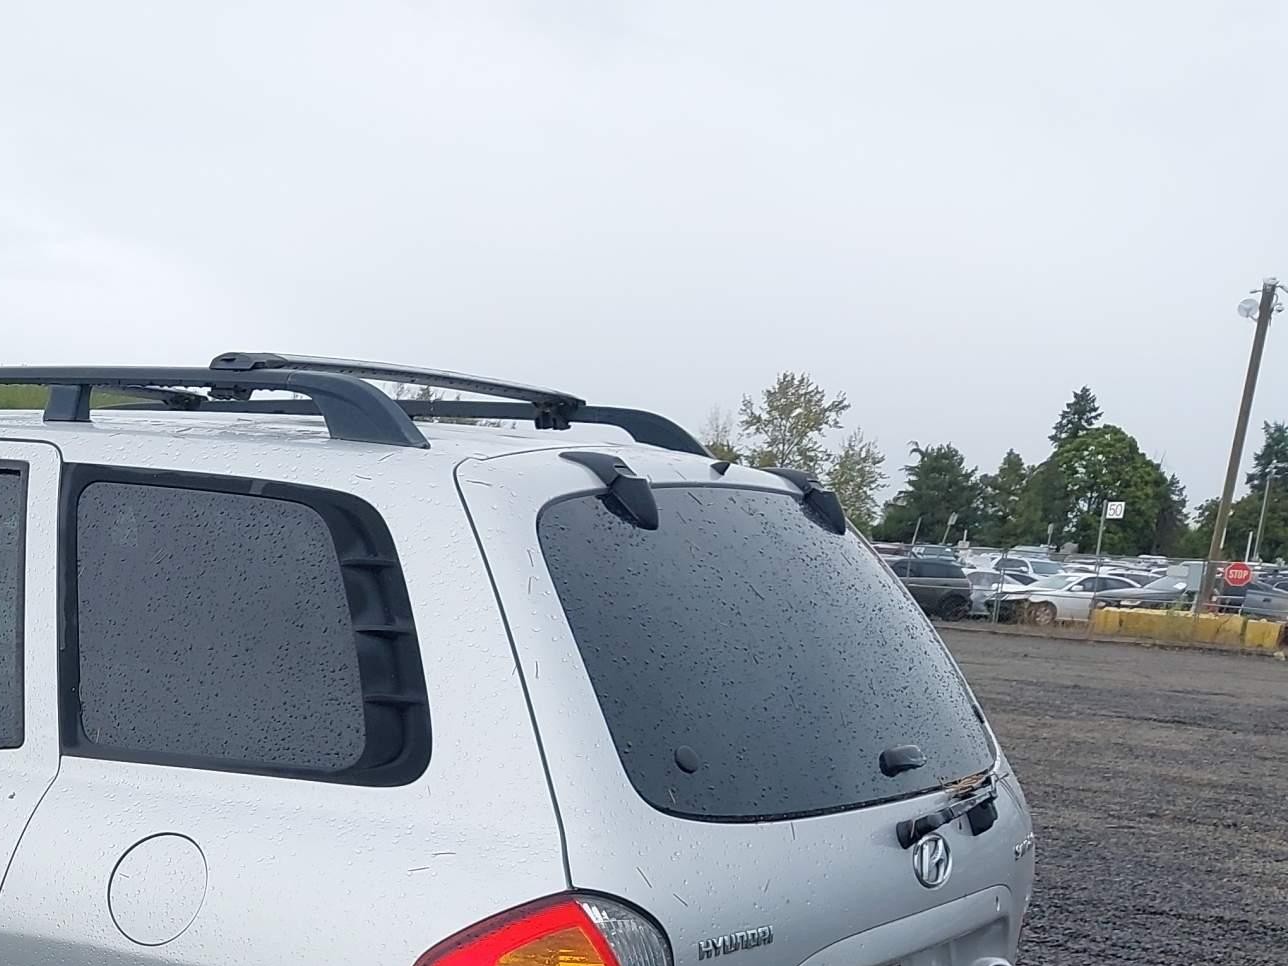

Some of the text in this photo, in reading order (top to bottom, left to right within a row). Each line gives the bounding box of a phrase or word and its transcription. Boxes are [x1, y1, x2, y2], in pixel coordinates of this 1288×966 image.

[1108, 503, 1123, 517] 50
[1228, 569, 1249, 580] STOP
[698, 925, 775, 961] HYUNDAI
